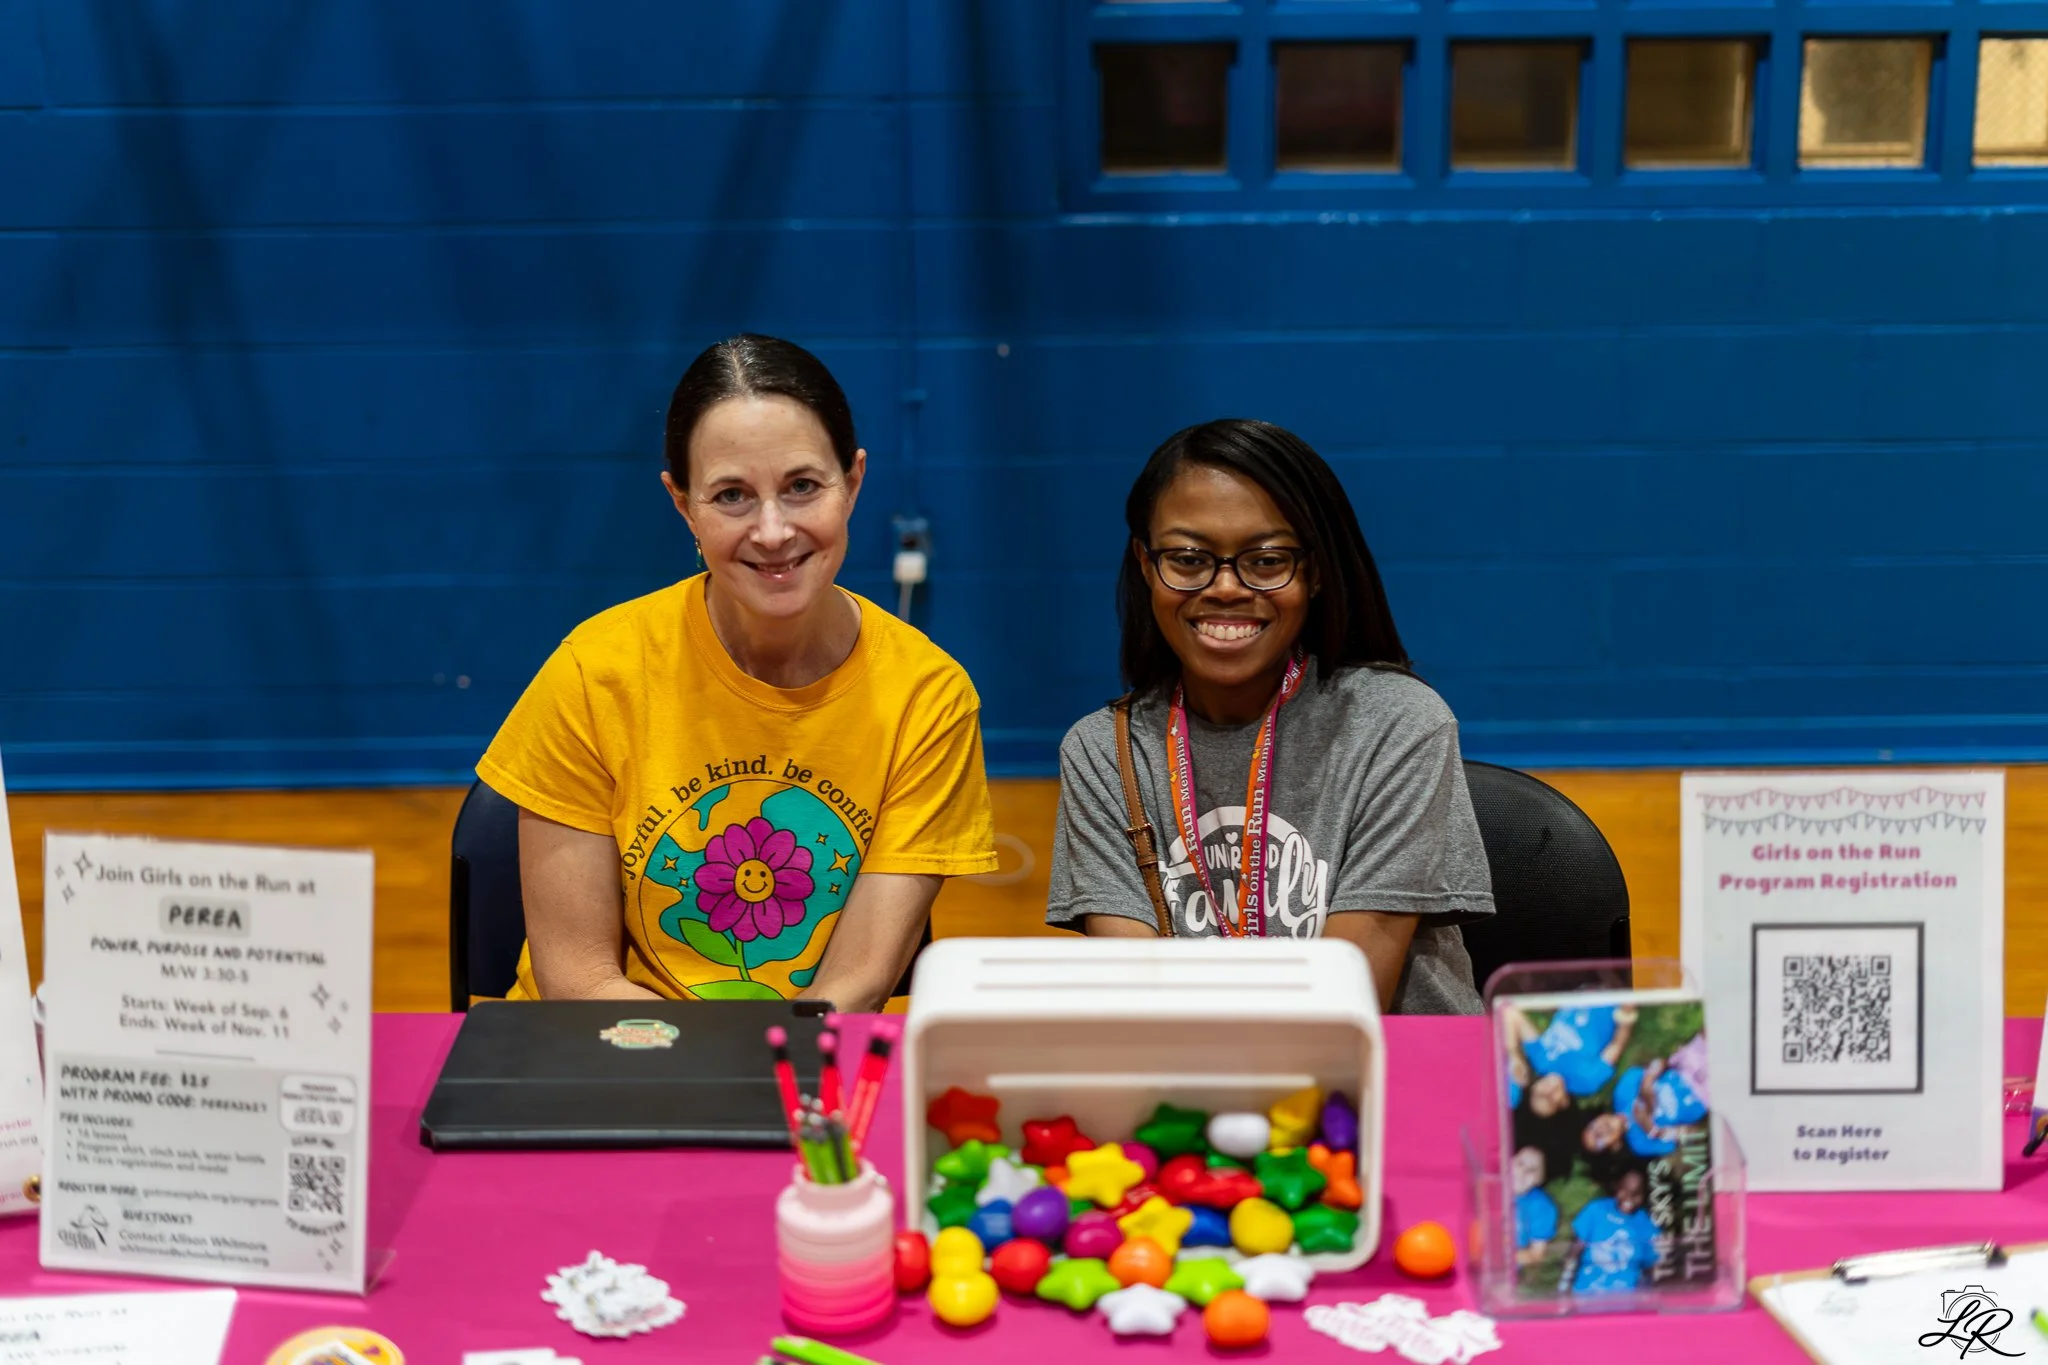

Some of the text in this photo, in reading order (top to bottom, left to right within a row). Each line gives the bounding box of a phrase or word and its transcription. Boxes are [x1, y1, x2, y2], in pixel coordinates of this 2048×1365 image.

[1257, 715, 1272, 782] Memphis
[670, 775, 702, 803] be
[705, 755, 774, 783] kind.
[783, 759, 813, 783] be
[1177, 736, 1190, 801] Memphis
[1247, 788, 1264, 836] Run
[1181, 804, 1199, 854] Run
[1249, 839, 1261, 867] the
[1752, 844, 1921, 861] Girls on the Run
[96, 865, 316, 894] Join Girls on the Run at
[1250, 869, 1260, 892] on
[1719, 871, 1958, 895] Program Registration
[168, 905, 242, 930] PEREA
[91, 937, 325, 966] POWER, PURPOSE AND POTENTIAL
[173, 997, 216, 1015] Week
[221, 1001, 237, 1016] of
[164, 1016, 205, 1033] Week
[211, 1020, 227, 1034] of
[273, 1024, 290, 1039] 11
[61, 1065, 135, 1084] PROGRAM
[60, 1087, 98, 1101] WITH
[103, 1088, 152, 1104] PROMO
[1797, 1125, 1882, 1138] Scan Here
[1793, 1146, 1889, 1165] to Register
[1678, 1125, 1712, 1280] THE LIMIT
